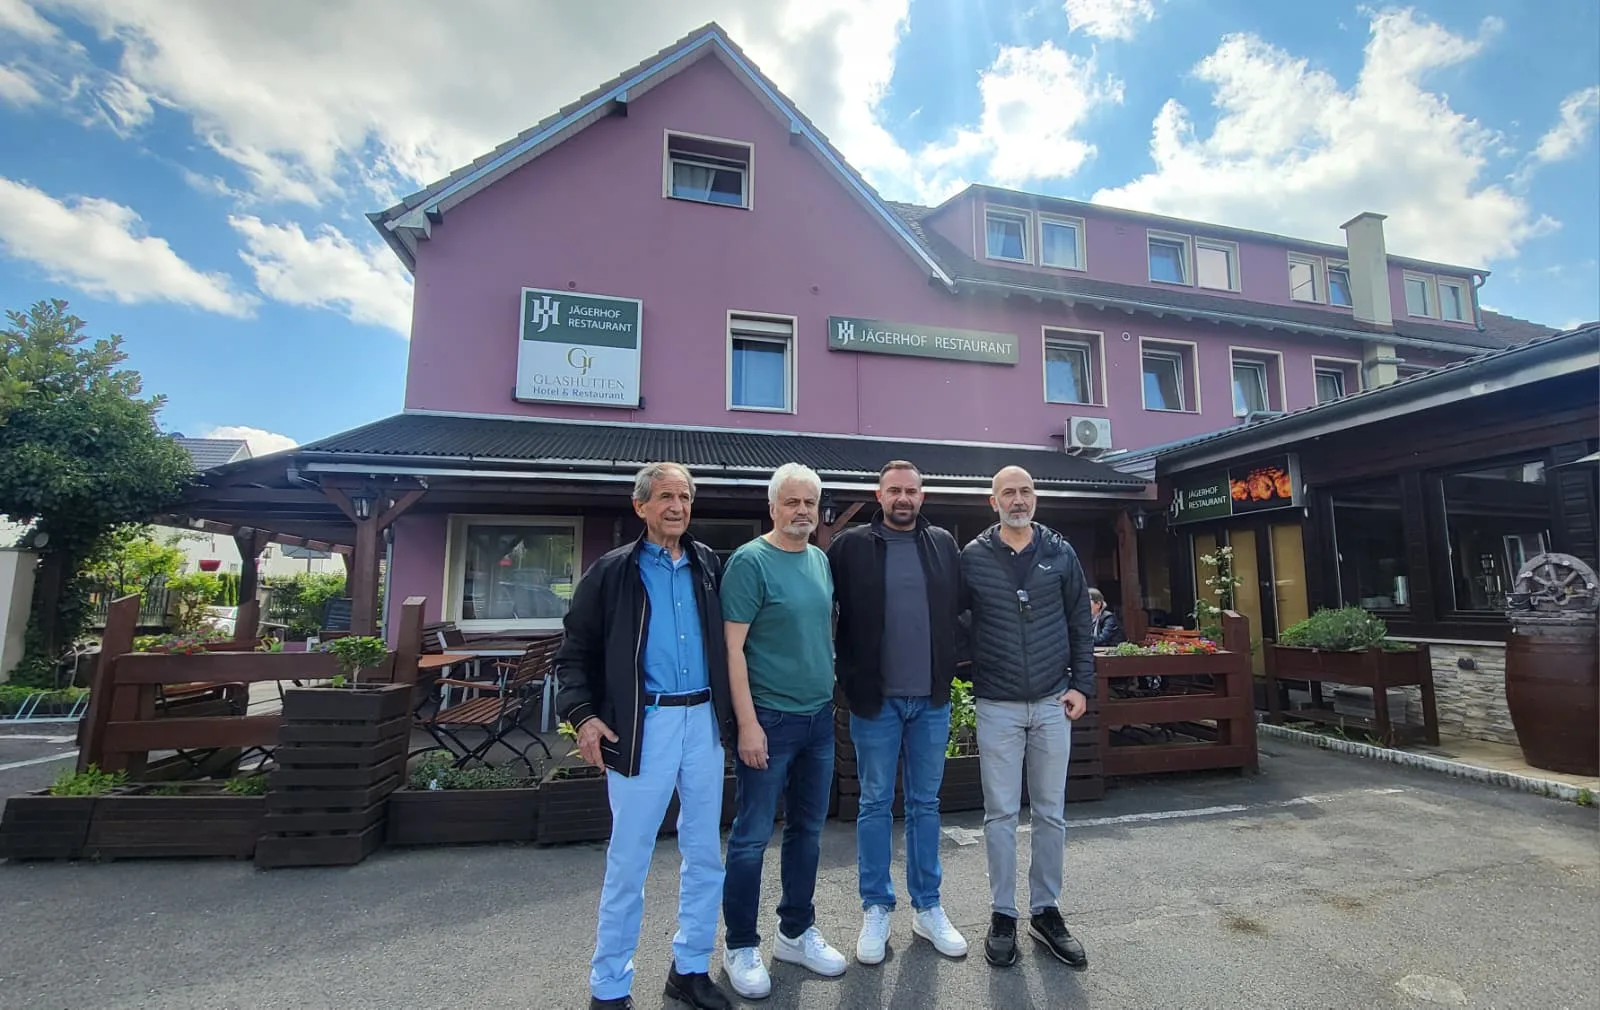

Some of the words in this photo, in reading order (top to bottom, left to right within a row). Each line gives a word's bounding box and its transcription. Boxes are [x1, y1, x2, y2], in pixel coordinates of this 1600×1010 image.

[568, 305, 622, 318] JÄGERHOF
[568, 318, 632, 332] RESTAURANT
[860, 328, 928, 347] JÄGERHOF
[935, 336, 1012, 355] RESTAURANT
[533, 386, 559, 396] Hotel
[562, 388, 569, 397] &
[572, 388, 625, 401] Restaurant
[1188, 495, 1227, 509] RESTAURANT
